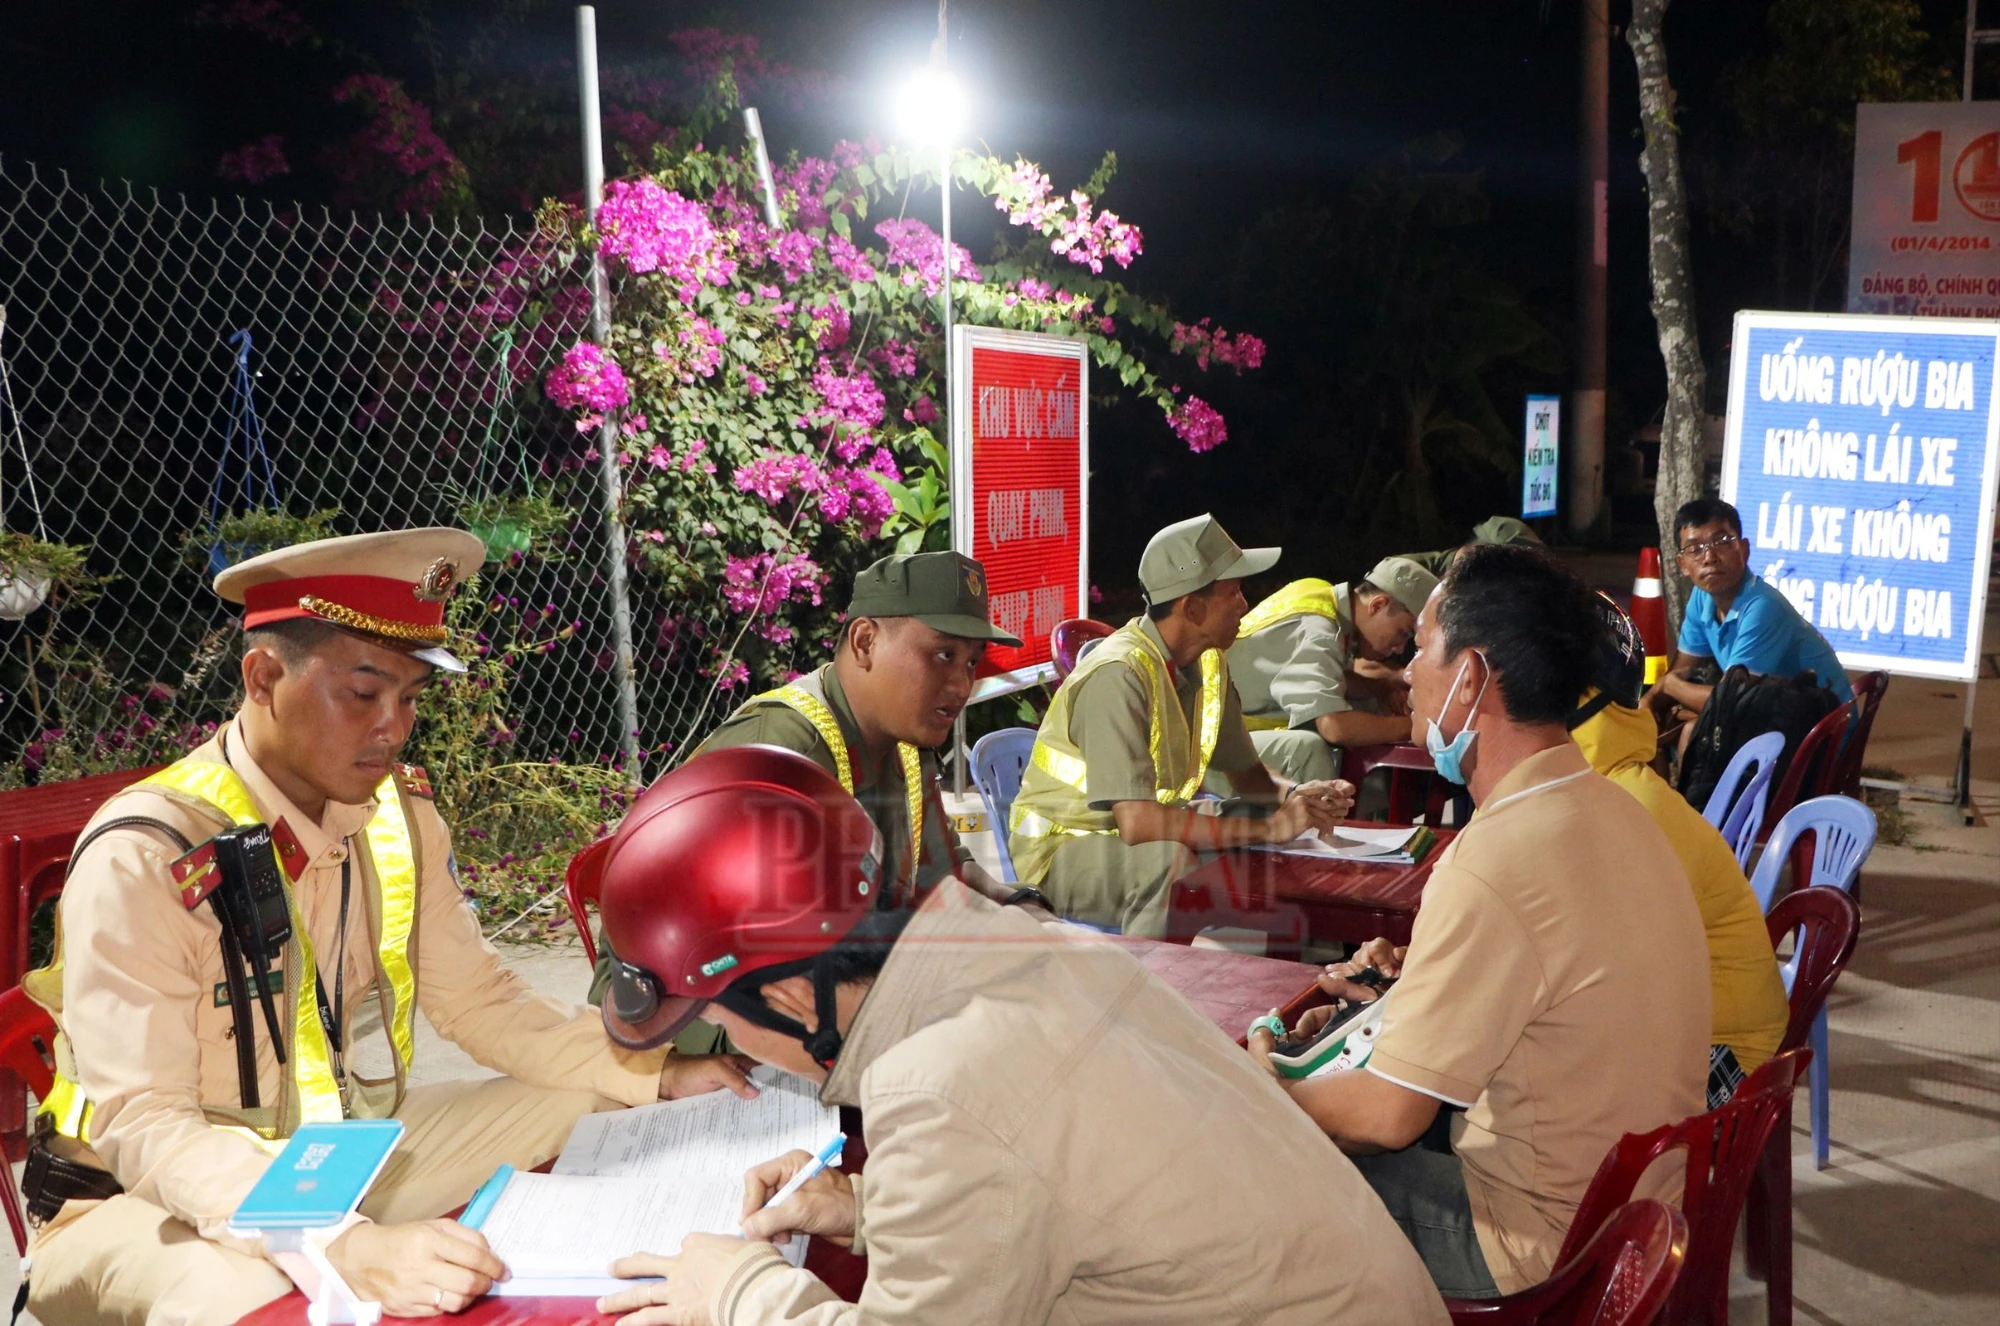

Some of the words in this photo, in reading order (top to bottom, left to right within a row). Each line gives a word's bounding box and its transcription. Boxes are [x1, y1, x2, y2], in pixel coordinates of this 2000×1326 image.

[1891, 237, 1990, 252] (01/4/2014
[1862, 272, 1904, 294] ĐẢNG
[1908, 274, 1931, 298] BỘ,
[1936, 274, 1982, 296] CHÍNH
[1760, 337, 1834, 405] UỐNG
[1840, 349, 1919, 417] RƯỢU
[1924, 360, 1975, 411] BIA
[979, 386, 1010, 439] KHU
[1763, 418, 1859, 481] KHÔNG
[1864, 423, 1912, 484] LÁI
[1916, 437, 1958, 486] XE
[1756, 491, 1800, 550] LÁI
[1806, 506, 1847, 554] XE
[1851, 500, 1951, 563] KHÔNG
[1820, 575, 1898, 641] RƯỢU
[1904, 588, 1951, 639] BIA
